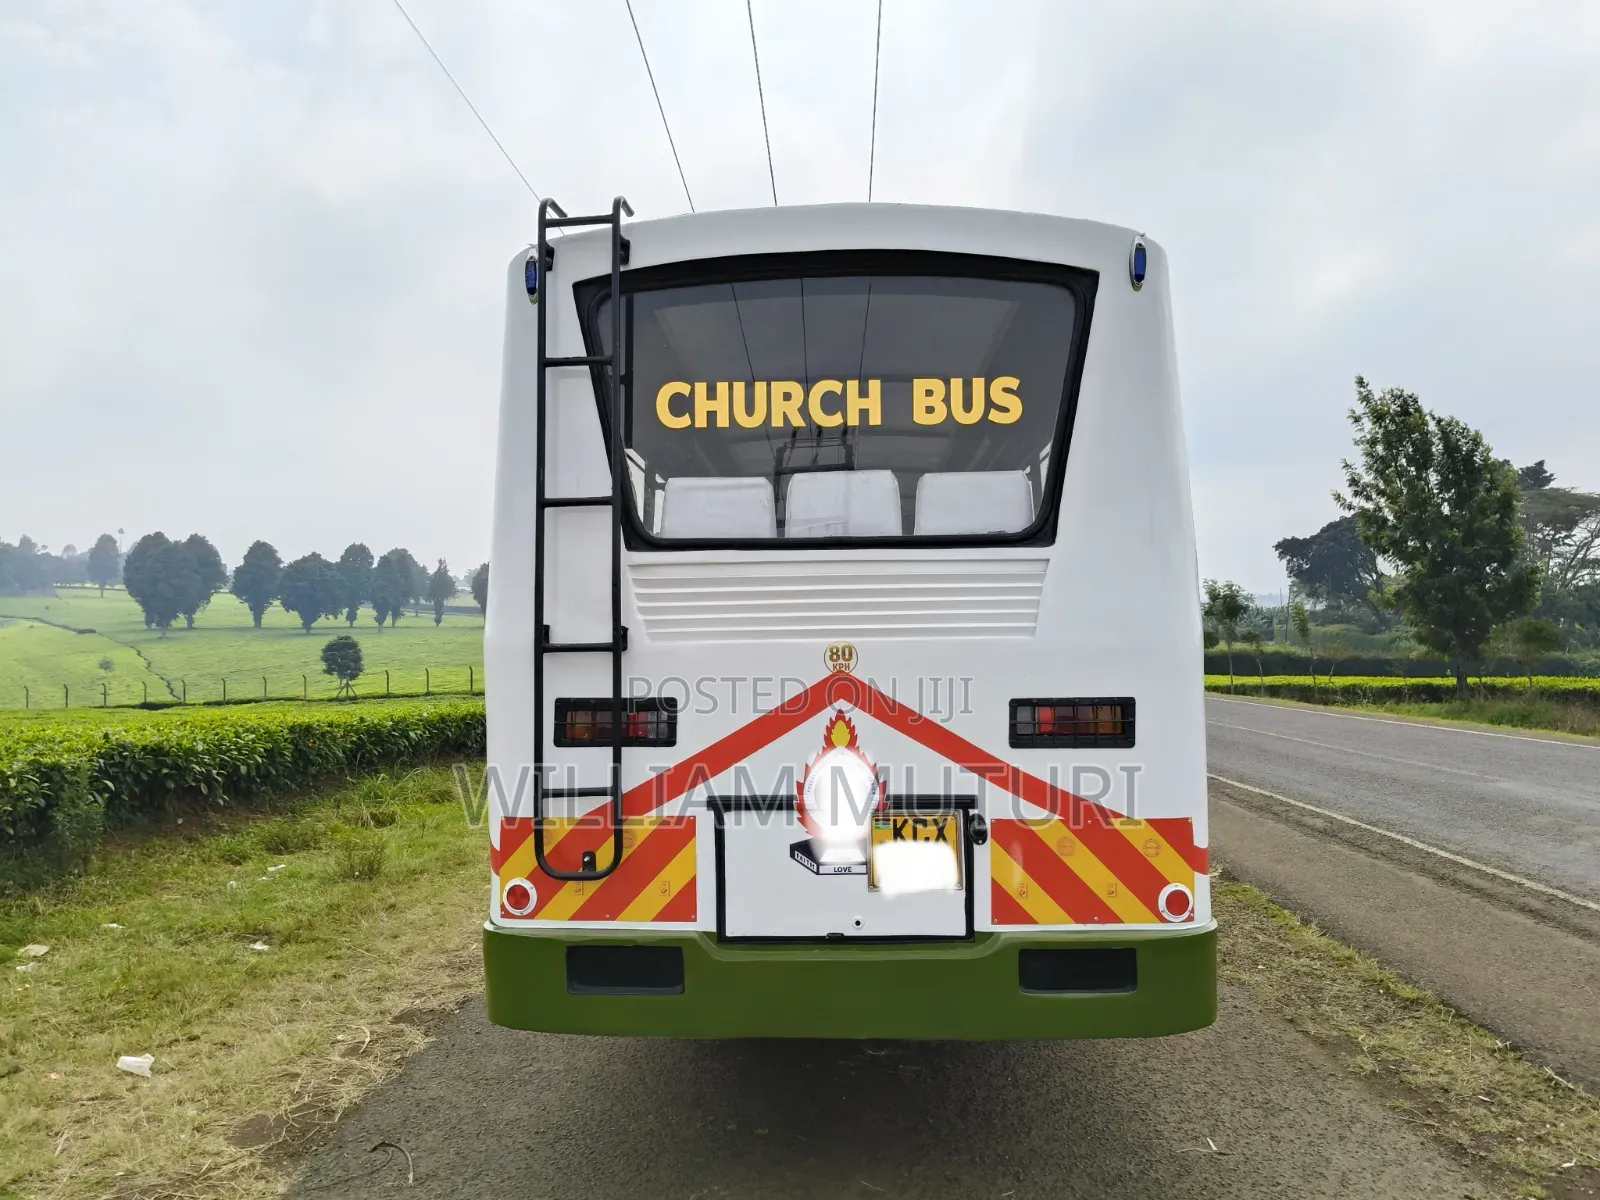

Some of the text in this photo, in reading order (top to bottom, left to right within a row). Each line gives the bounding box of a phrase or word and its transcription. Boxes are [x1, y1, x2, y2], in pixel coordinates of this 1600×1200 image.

[656, 376, 1023, 429] CHURCH BUS
[829, 644, 853, 662] 80
[832, 662, 851, 671] KPH
[796, 851, 815, 870] FAITH
